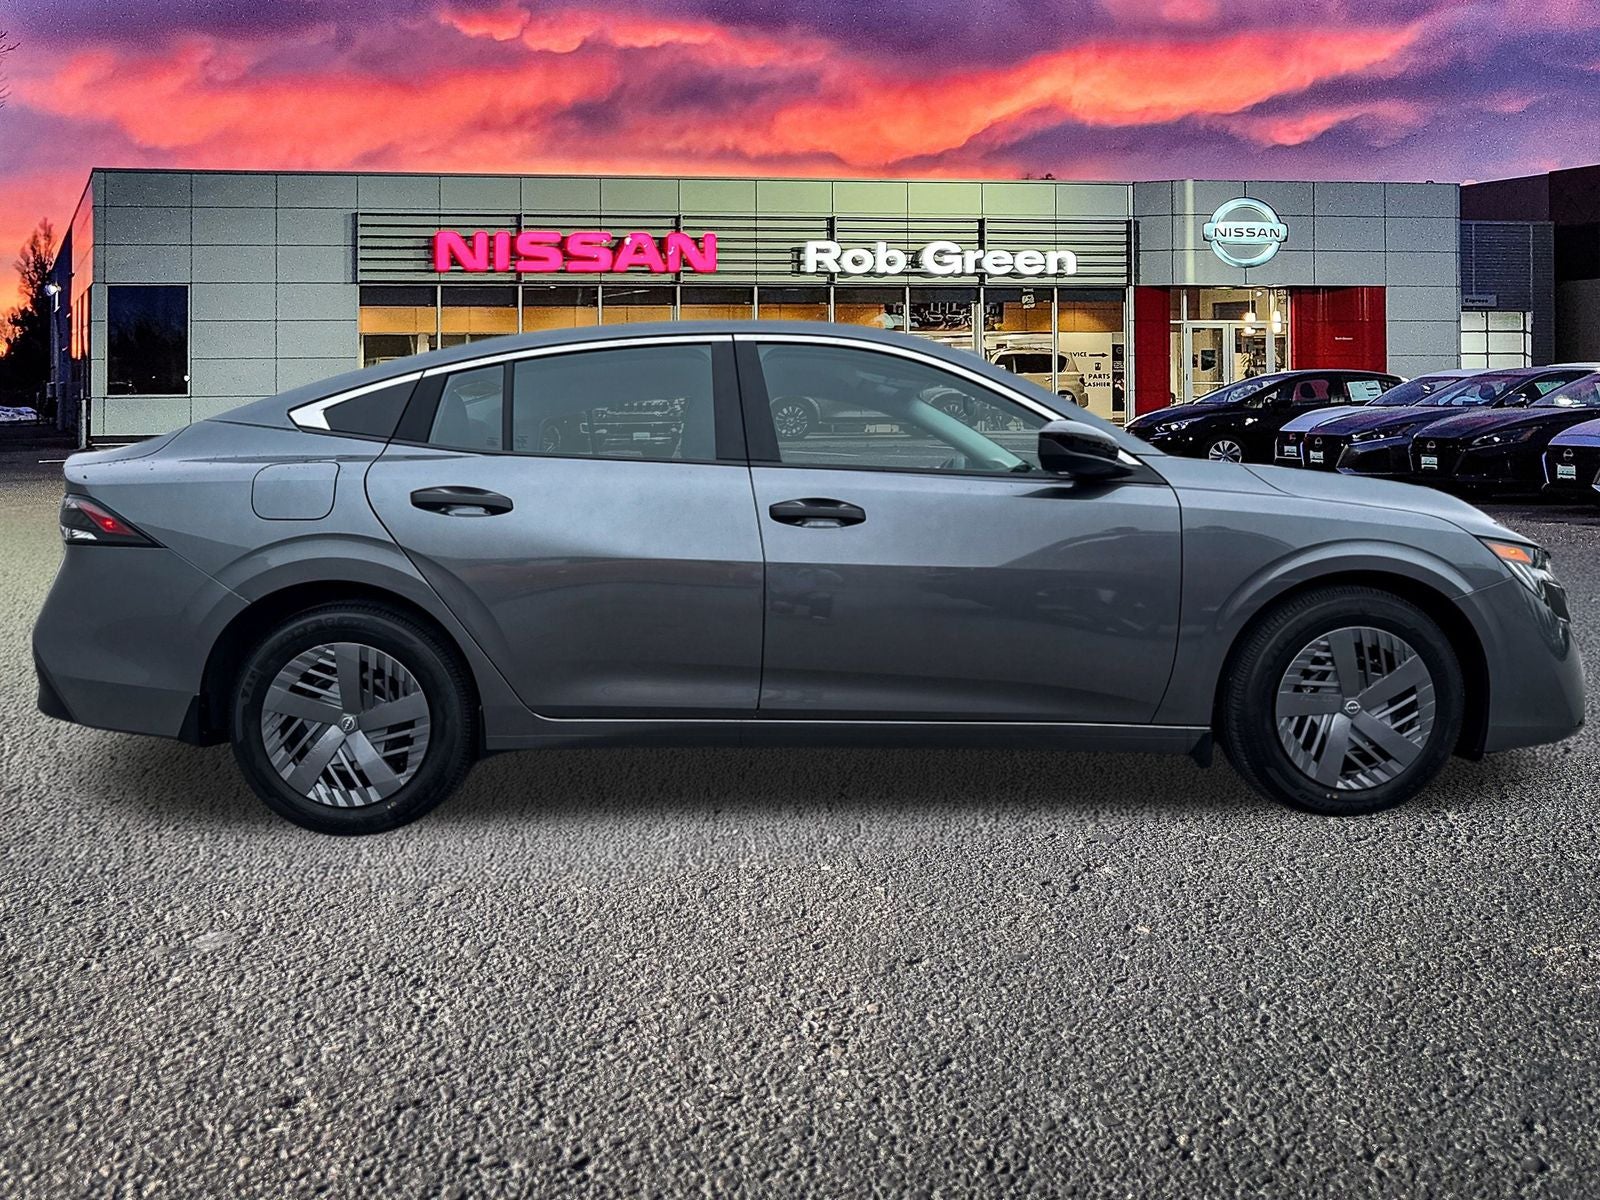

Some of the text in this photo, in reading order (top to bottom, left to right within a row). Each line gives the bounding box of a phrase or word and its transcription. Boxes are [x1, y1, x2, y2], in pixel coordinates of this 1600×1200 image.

[1214, 227, 1280, 238] NISSAN
[433, 229, 718, 273] NISSAN
[804, 240, 1078, 275] Rob Green
